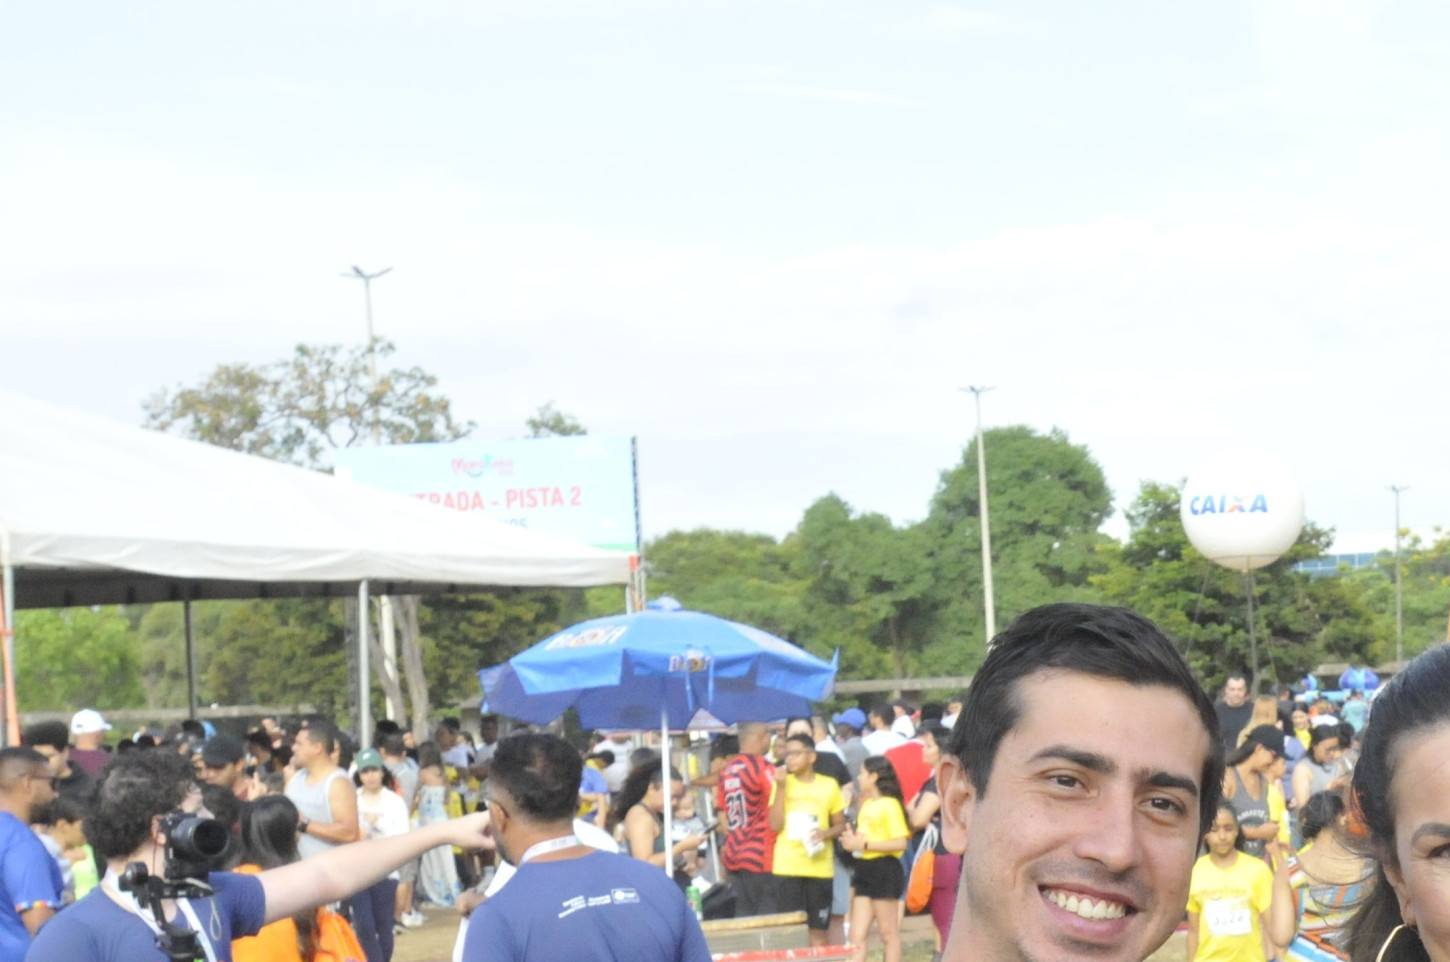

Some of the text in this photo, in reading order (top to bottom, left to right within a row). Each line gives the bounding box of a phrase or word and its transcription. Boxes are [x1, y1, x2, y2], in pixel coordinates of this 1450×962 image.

[505, 487, 564, 509] PISTA
[570, 486, 582, 506] 2
[1190, 495, 1268, 515] CAIXA
